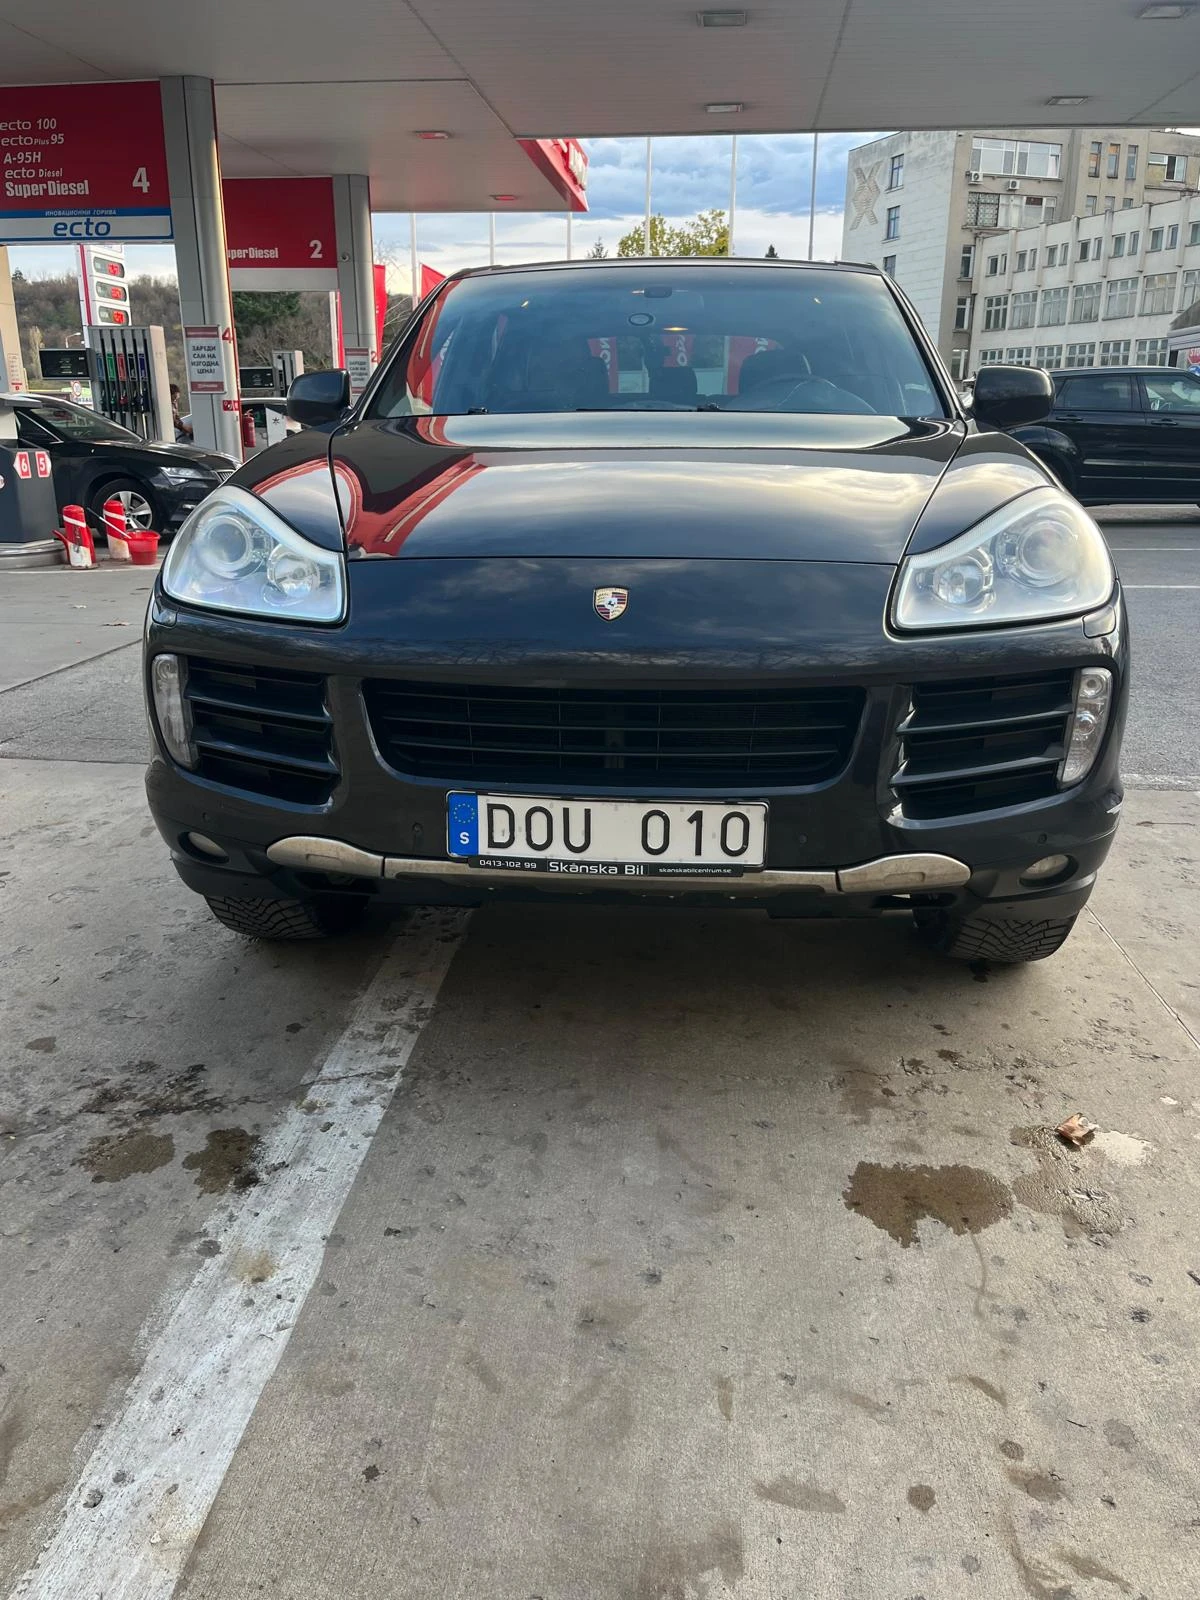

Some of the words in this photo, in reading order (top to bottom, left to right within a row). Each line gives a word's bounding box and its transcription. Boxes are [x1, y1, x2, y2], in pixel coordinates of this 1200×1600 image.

[0, 119, 32, 131] ecto
[36, 118, 57, 130] 100
[1, 134, 33, 147] ecto
[50, 133, 65, 145] 95
[3, 151, 42, 165] A-95H
[5, 167, 36, 179] ecto
[38, 167, 63, 178] Diesel
[132, 167, 150, 193] 4
[53, 217, 111, 237] ecto
[309, 240, 323, 259] 2
[21, 458, 28, 472] 6
[39, 457, 46, 471] 5
[487, 803, 592, 854] DOU
[641, 809, 750, 857] 010
[459, 831, 470, 845] S
[479, 859, 521, 868] 0413-102
[549, 861, 618, 875] Skånska
[624, 864, 644, 875] Bil
